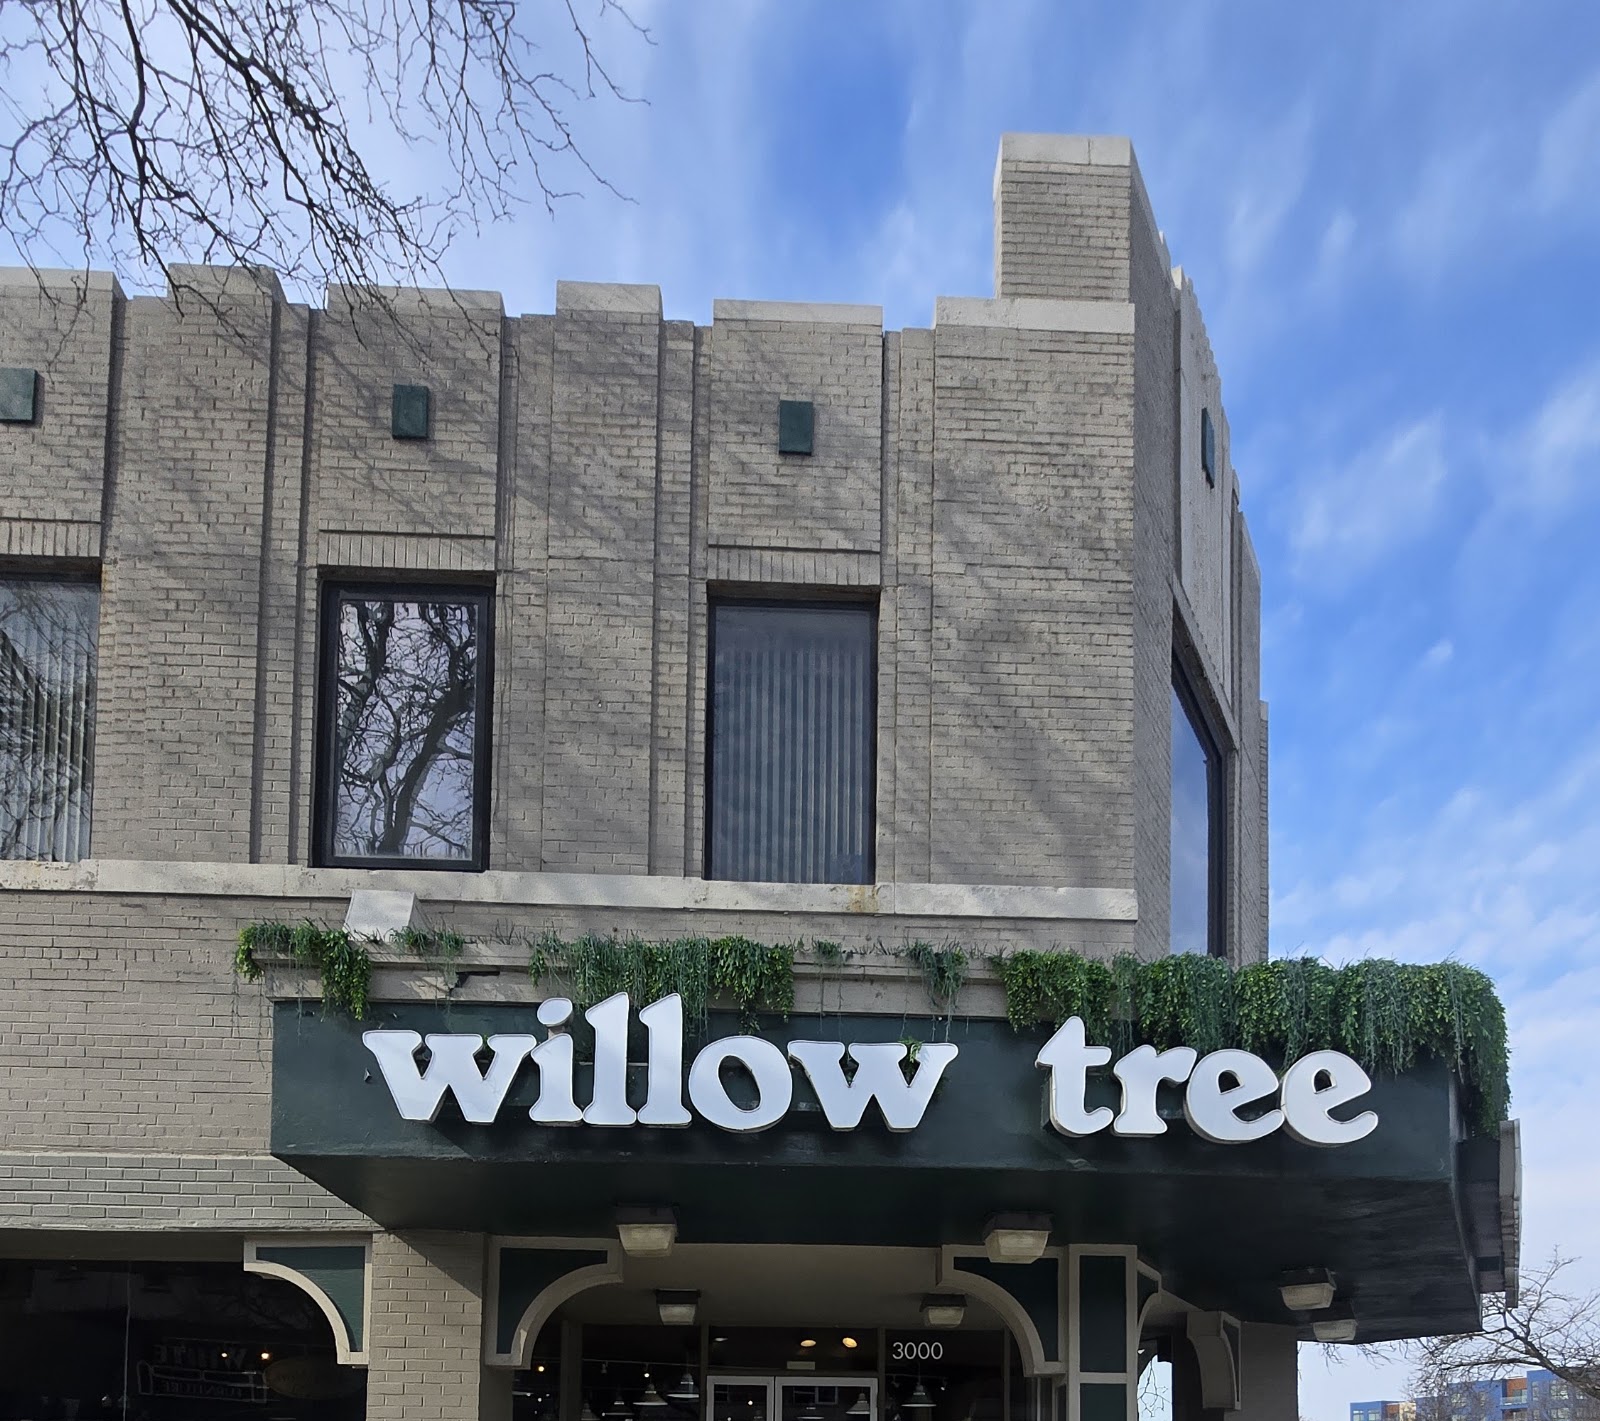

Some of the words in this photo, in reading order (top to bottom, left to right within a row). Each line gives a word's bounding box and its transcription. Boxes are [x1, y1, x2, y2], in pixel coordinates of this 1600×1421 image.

[362, 992, 959, 1133] willow
[1035, 1015, 1379, 1147] tree
[892, 1342, 943, 1360] 3000
